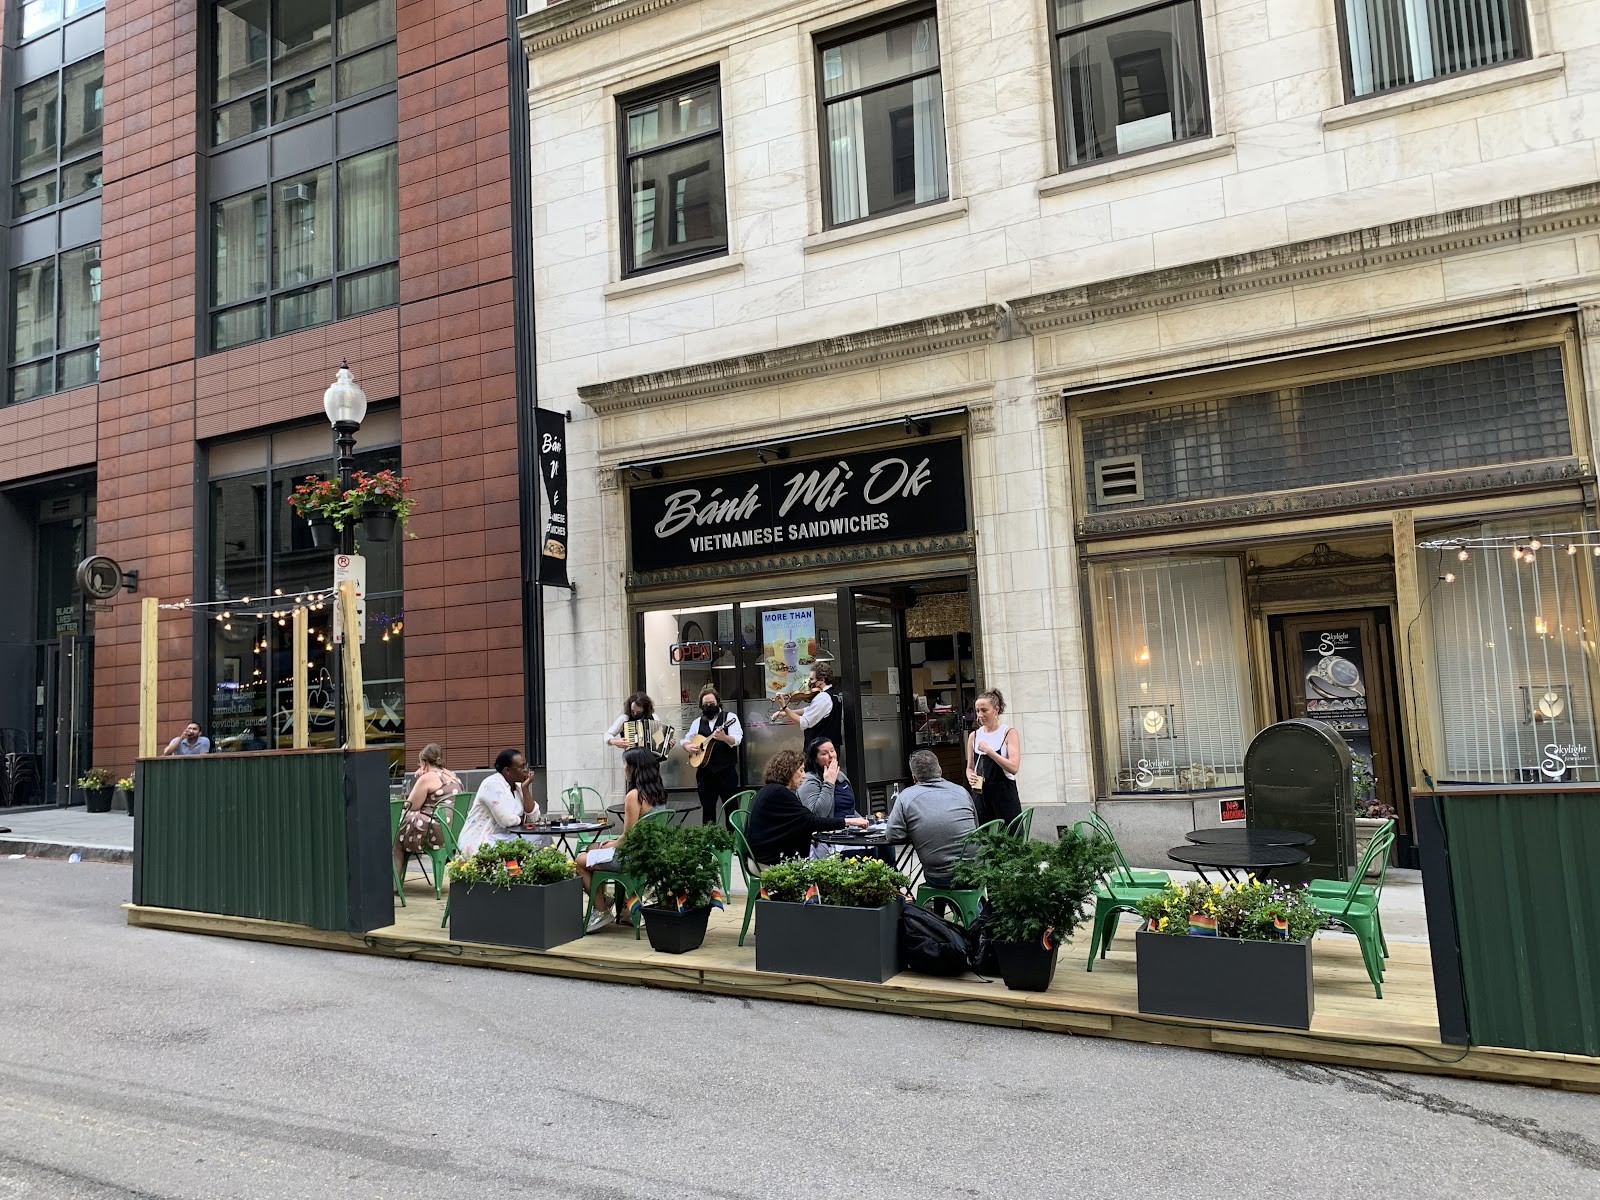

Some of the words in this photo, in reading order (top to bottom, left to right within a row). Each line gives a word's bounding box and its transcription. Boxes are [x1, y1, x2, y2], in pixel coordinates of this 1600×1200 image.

[654, 483, 761, 539] Bánh
[778, 460, 853, 518] Mì
[863, 457, 932, 505] Ok
[689, 526, 784, 553] VIETNAMESE
[788, 512, 890, 541] SANDWICHES
[56, 606, 75, 616] BLACK
[764, 611, 788, 622] MORE
[789, 610, 813, 620] THAN
[56, 615, 72, 624] LIVES
[56, 622, 78, 632] MATTER
[1318, 632, 1349, 656] Skylight
[672, 644, 711, 663] OPEN
[1541, 744, 1588, 777] Skylight
[1136, 759, 1170, 787] Skylight
[1225, 801, 1239, 810] NO
[1222, 809, 1246, 820] SMOKING
